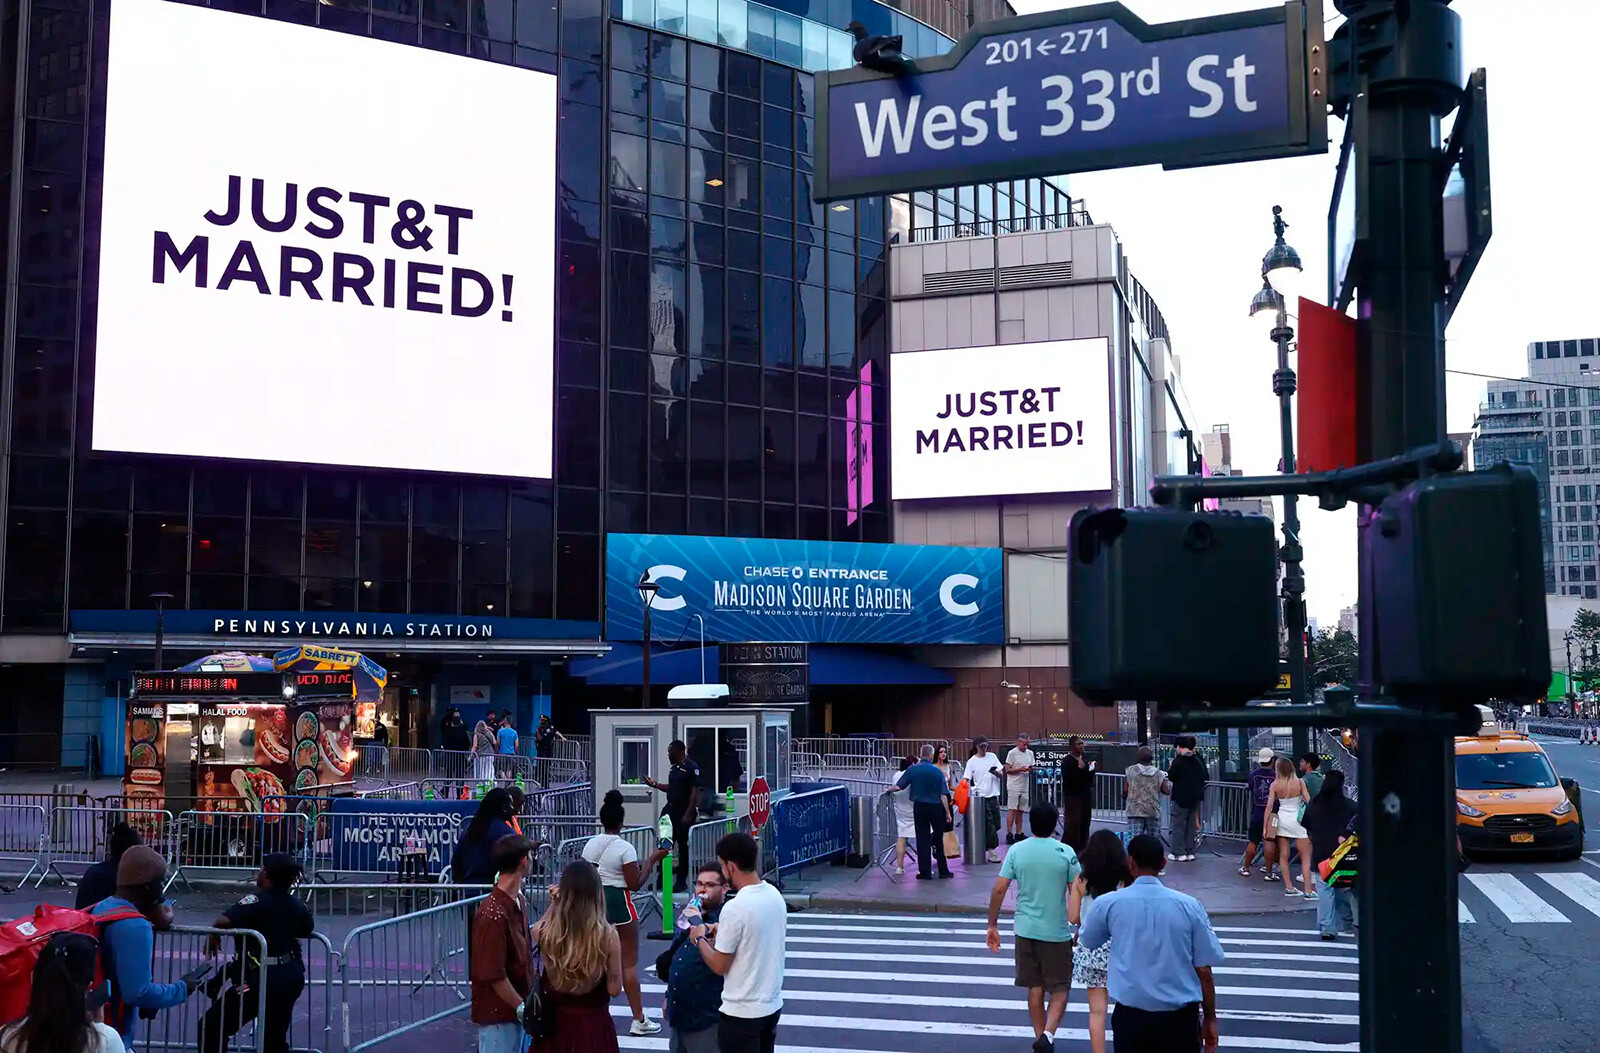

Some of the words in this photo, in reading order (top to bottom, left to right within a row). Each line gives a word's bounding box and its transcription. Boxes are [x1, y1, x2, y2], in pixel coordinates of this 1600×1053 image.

[985, 38, 1033, 66] 201
[1060, 26, 1109, 55] 271
[854, 84, 1018, 159] West
[1040, 57, 1161, 138] 33rd
[1186, 53, 1258, 119] St
[203, 174, 473, 256] JUST&T
[152, 229, 514, 323] MARRIED!
[935, 386, 1061, 419] JUST&T
[915, 420, 1084, 454] MARRIED!
[744, 566, 790, 578] CHASE
[809, 568, 889, 581] ENTRANCE
[714, 580, 786, 608] MADISON
[792, 581, 850, 609] SQUARE
[939, 573, 980, 617] C
[763, 609, 800, 617] WORLD'S
[214, 618, 394, 636] PENNSYLVANIA
[406, 623, 493, 637] STATION
[304, 648, 358, 663] SABRETT
[764, 645, 803, 660] STATION
[202, 708, 226, 716] HALAL
[227, 708, 248, 716] FOOD
[1035, 751, 1046, 760] 34
[1036, 759, 1054, 767] Penn
[750, 791, 769, 814] STOP
[359, 812, 388, 826] THE
[344, 827, 395, 844] MOST
